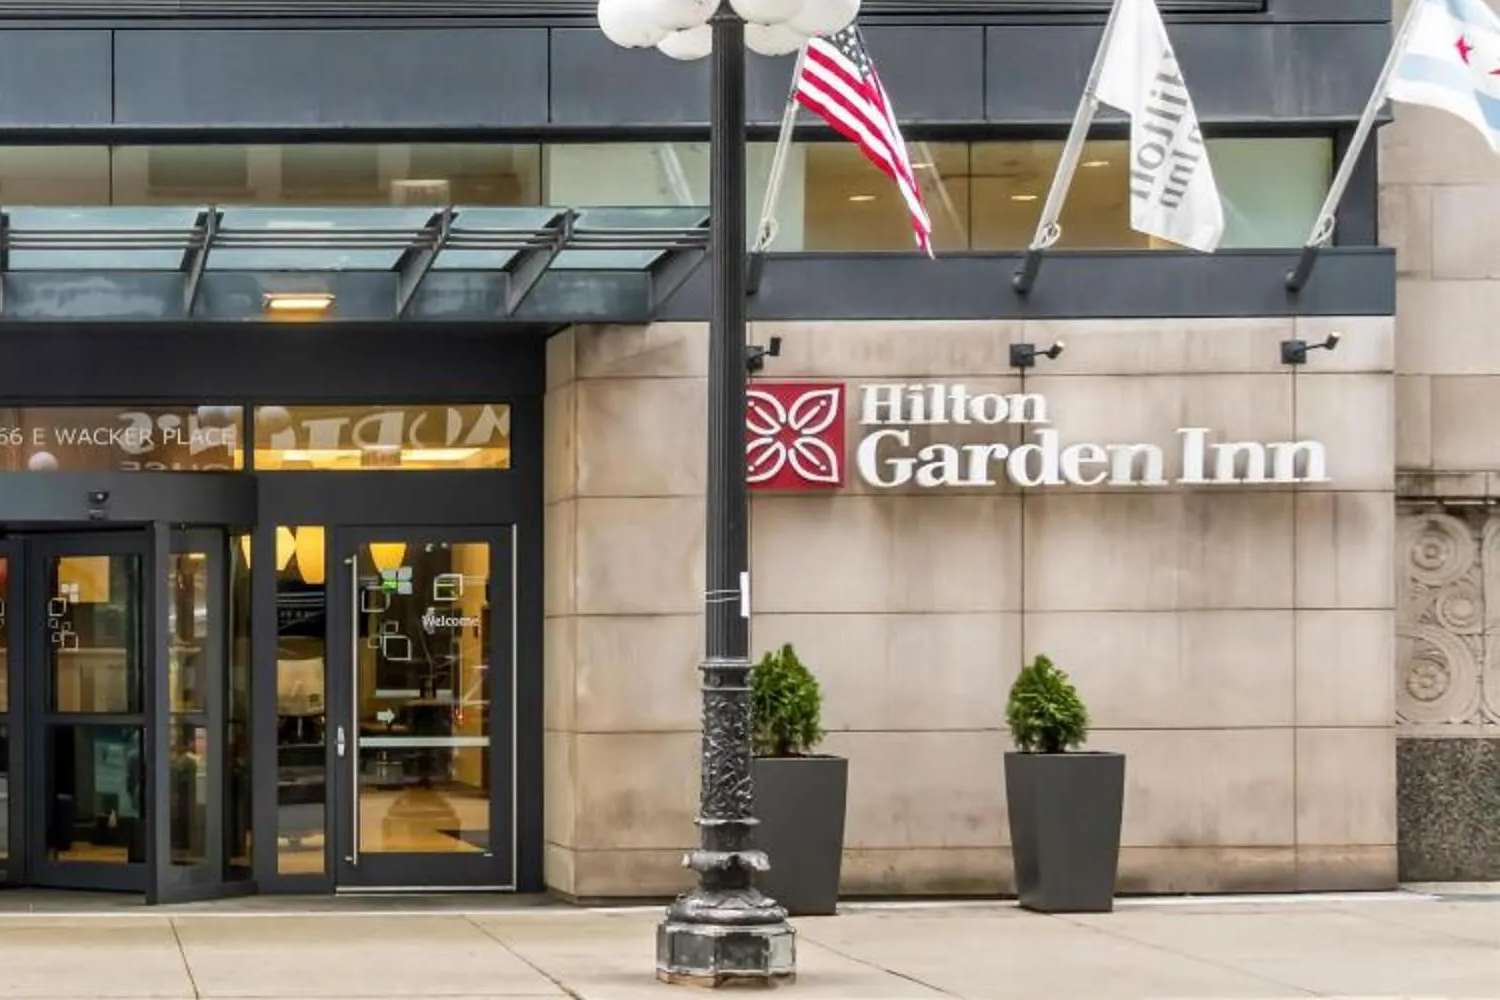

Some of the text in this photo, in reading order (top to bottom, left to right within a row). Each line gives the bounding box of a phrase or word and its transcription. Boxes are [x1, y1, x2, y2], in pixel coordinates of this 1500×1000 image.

[858, 383, 1051, 425] Hilton
[33, 427, 46, 445] E
[54, 427, 152, 446] WACKER
[163, 428, 236, 446] PLACE
[856, 427, 1331, 488] Garden Inn
[421, 615, 481, 628] Welcome
